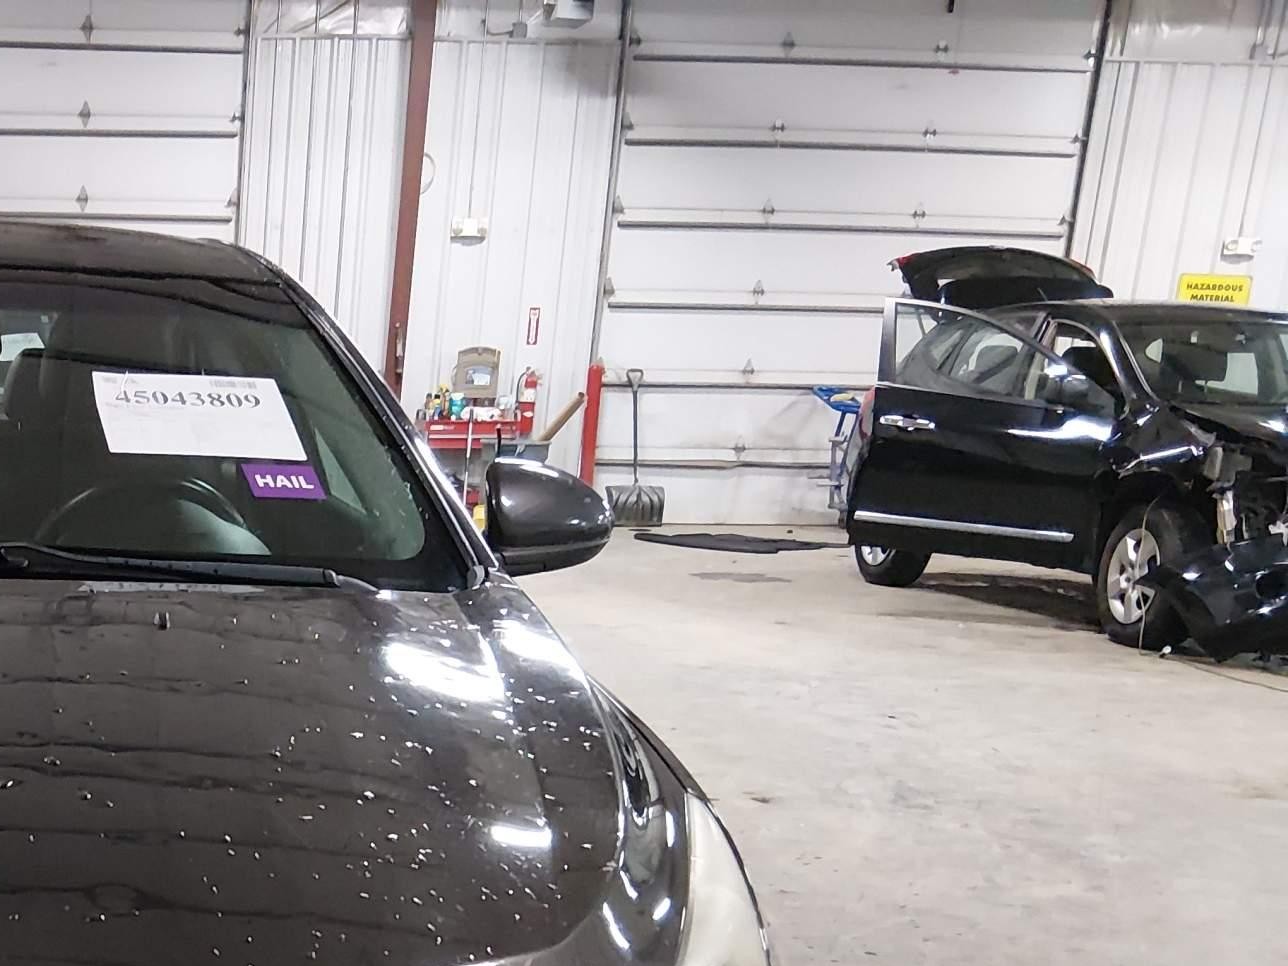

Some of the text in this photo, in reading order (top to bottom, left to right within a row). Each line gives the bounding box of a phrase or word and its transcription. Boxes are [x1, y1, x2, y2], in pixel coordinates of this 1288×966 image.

[1186, 282, 1244, 292] HAZARDOUS
[1190, 294, 1234, 303] MATERIAL
[115, 390, 261, 409] 45043809
[254, 473, 315, 490] HAIL
